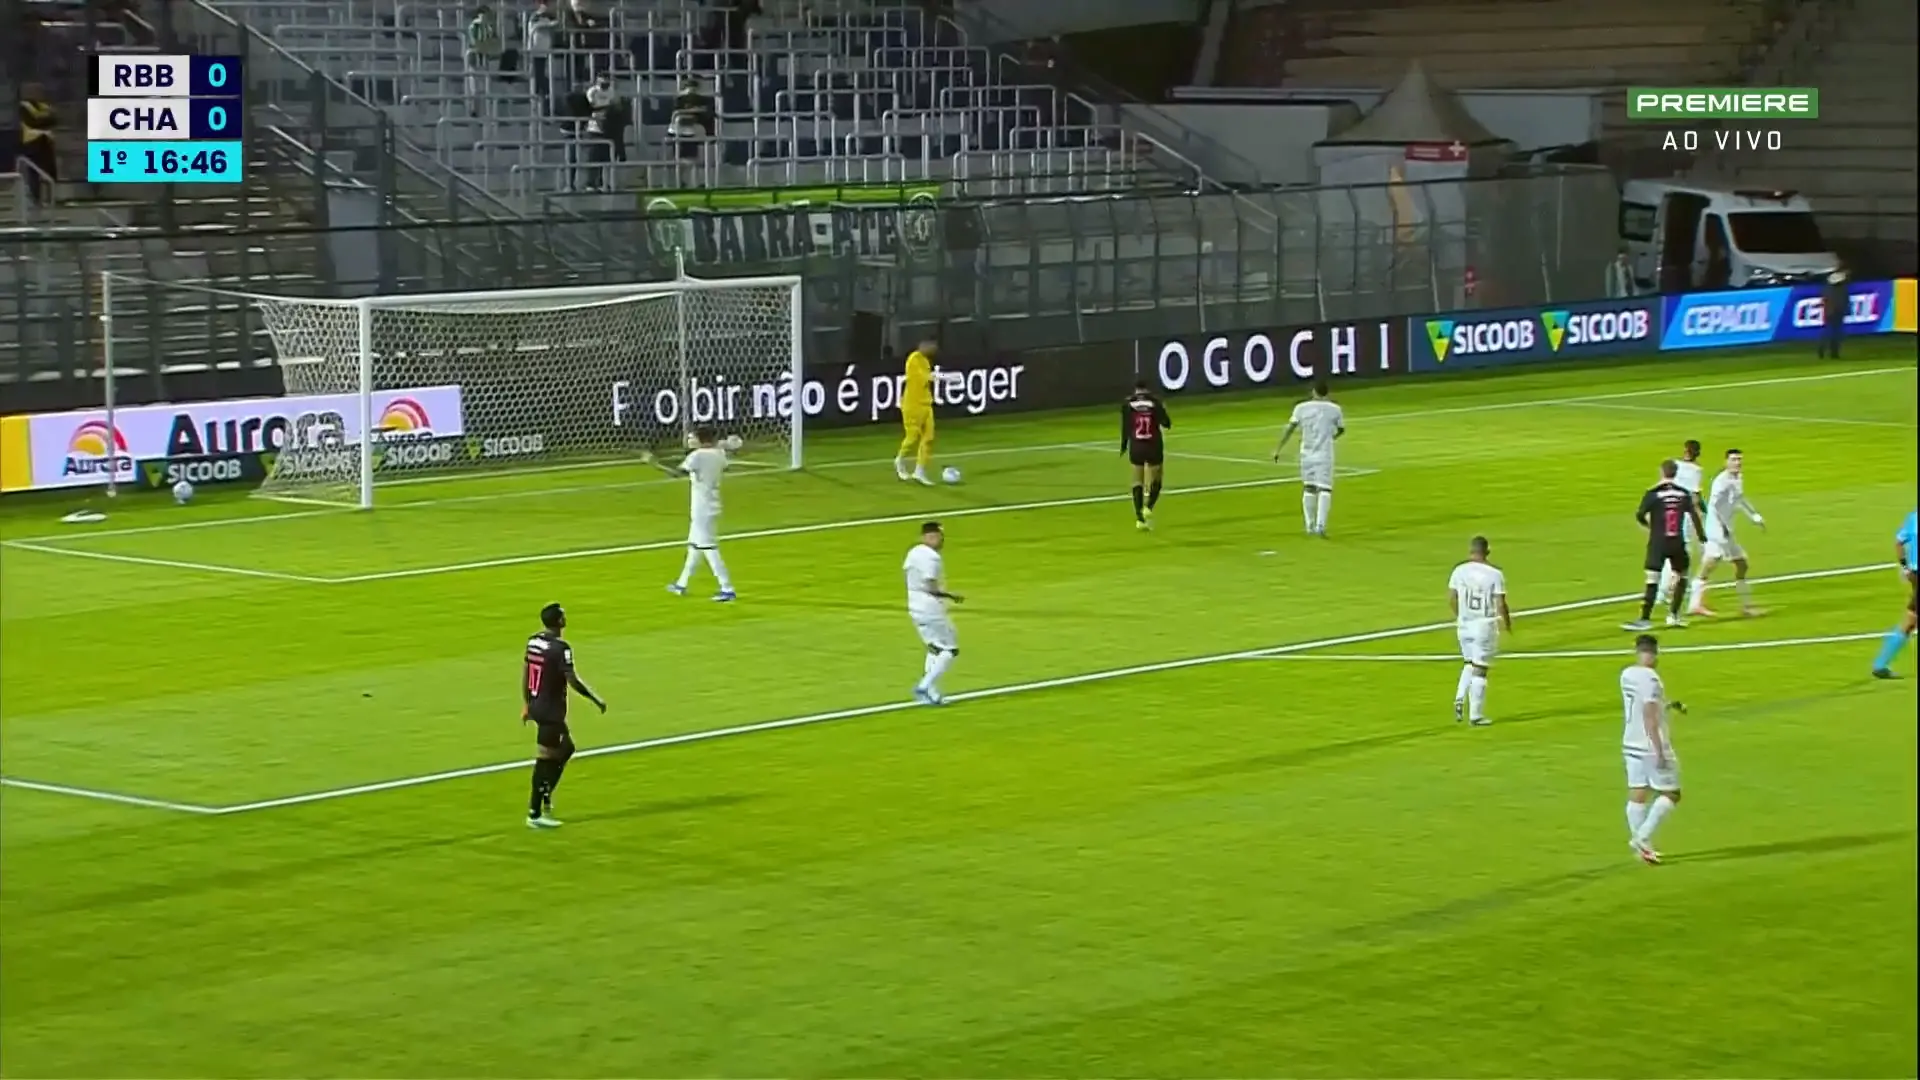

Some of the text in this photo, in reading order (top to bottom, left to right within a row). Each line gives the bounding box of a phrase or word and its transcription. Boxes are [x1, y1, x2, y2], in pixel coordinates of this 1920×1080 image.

[1454, 319, 1534, 354] SICOOB
[1567, 310, 1649, 344] SICOOB
[1158, 323, 1389, 391] OGOCHI
[752, 371, 822, 419] não
[837, 364, 859, 412] é
[871, 364, 1025, 421] prteger
[168, 411, 345, 456] Aurora
[484, 434, 543, 456] SICOOB
[385, 443, 452, 466] SICOOB
[168, 460, 242, 484] SICOOB
[528, 663, 542, 696] 17
